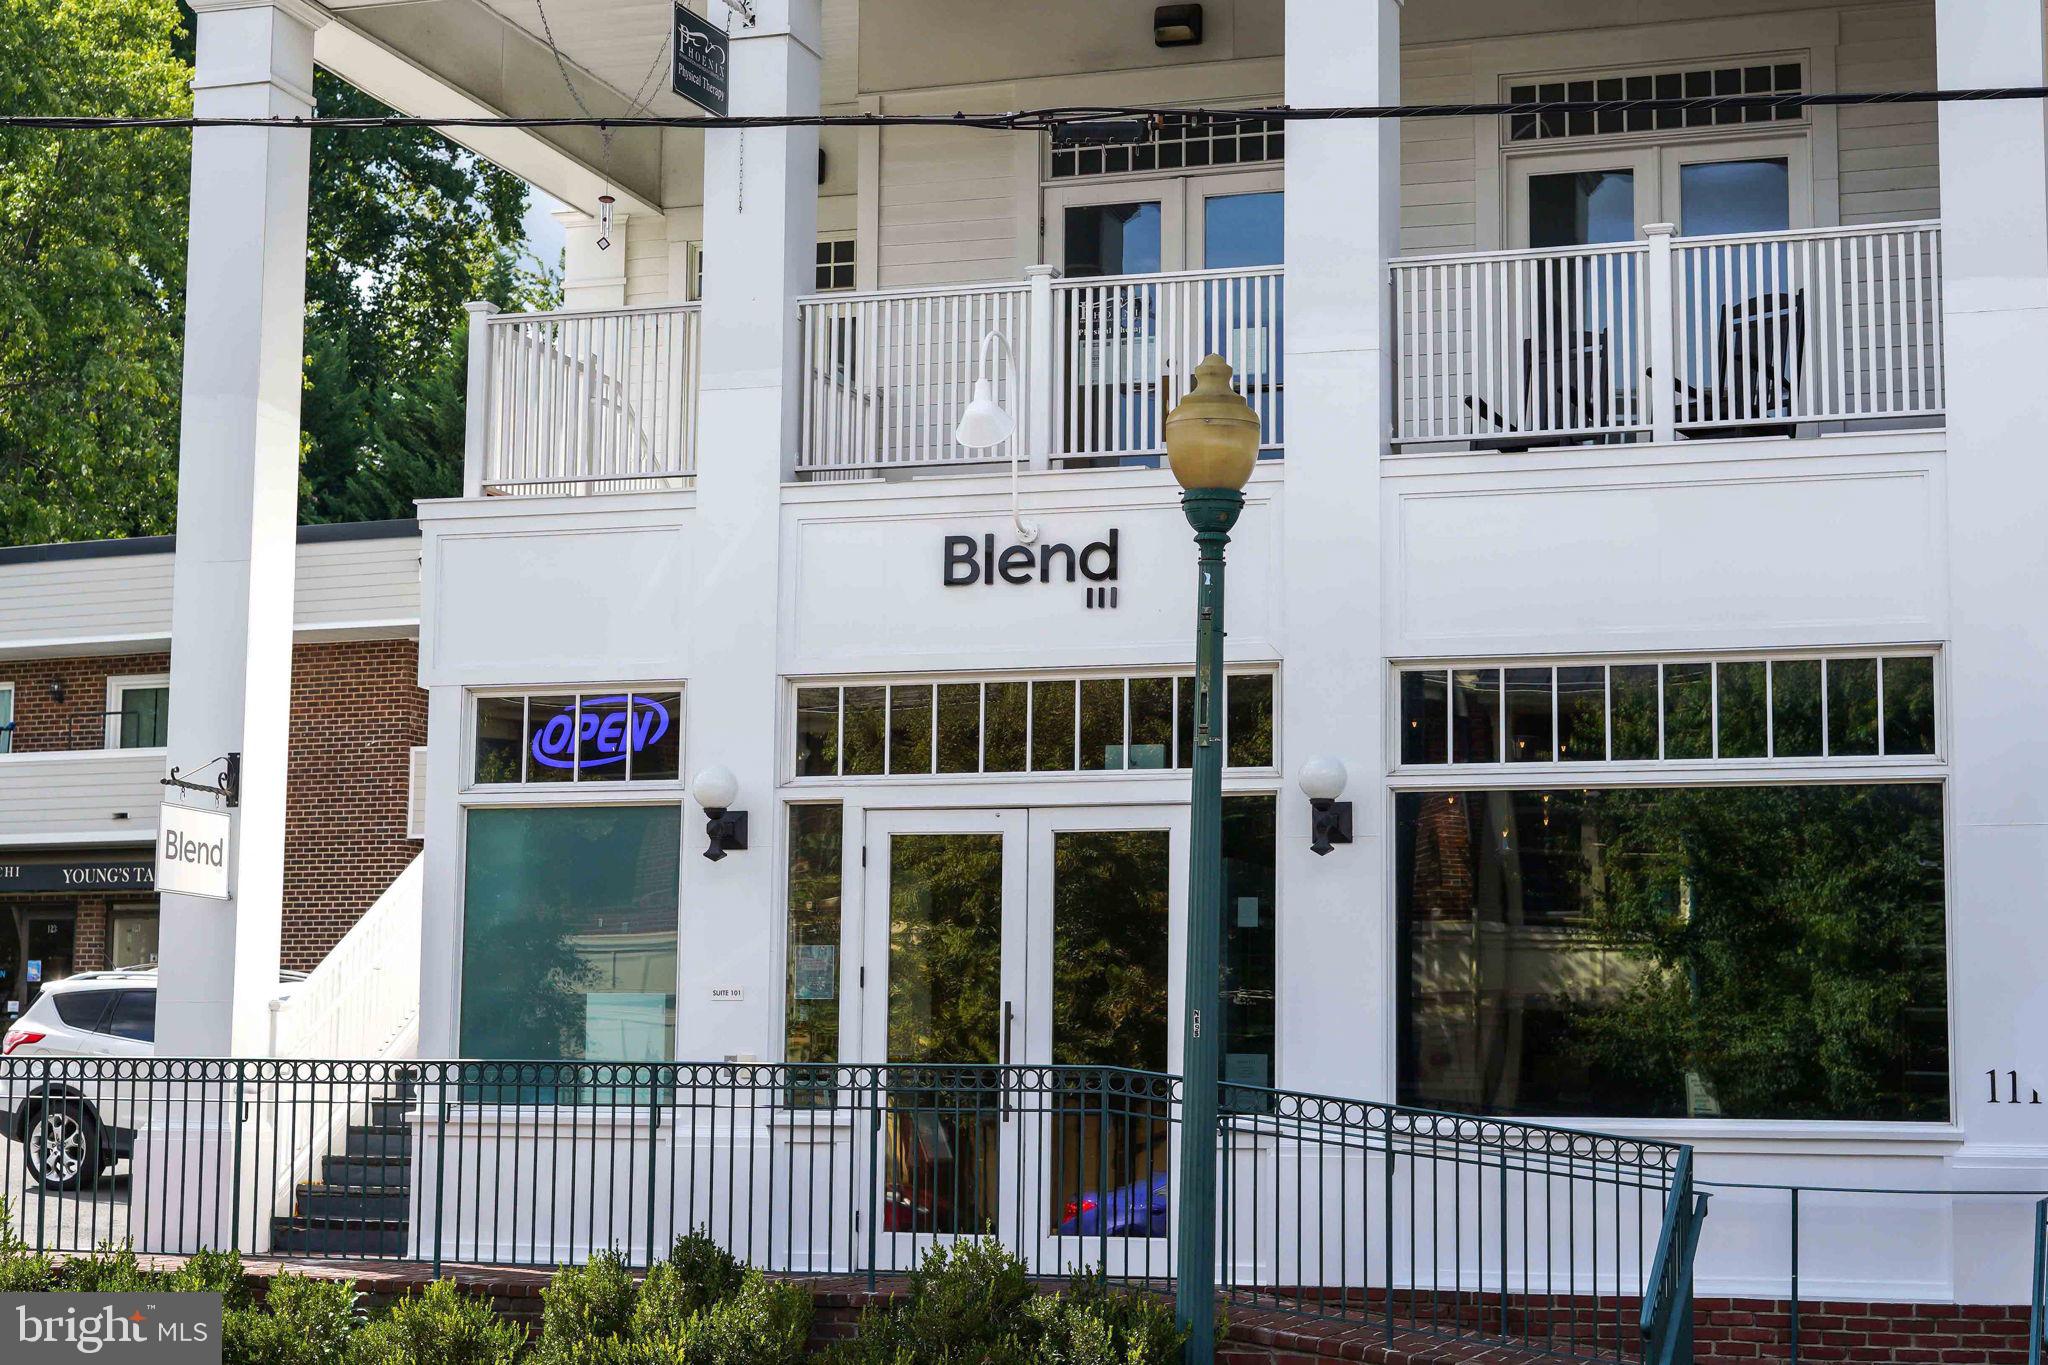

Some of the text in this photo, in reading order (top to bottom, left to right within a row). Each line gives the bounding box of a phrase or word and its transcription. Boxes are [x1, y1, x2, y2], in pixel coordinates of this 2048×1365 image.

[678, 23, 725, 78] PHOENIX
[678, 62, 701, 87] Physical
[702, 76, 724, 101] Therapy
[944, 528, 1119, 586] Blend
[541, 711, 655, 755] OPEN
[165, 829, 223, 867] Blend
[62, 867, 130, 884] YOUNG'S
